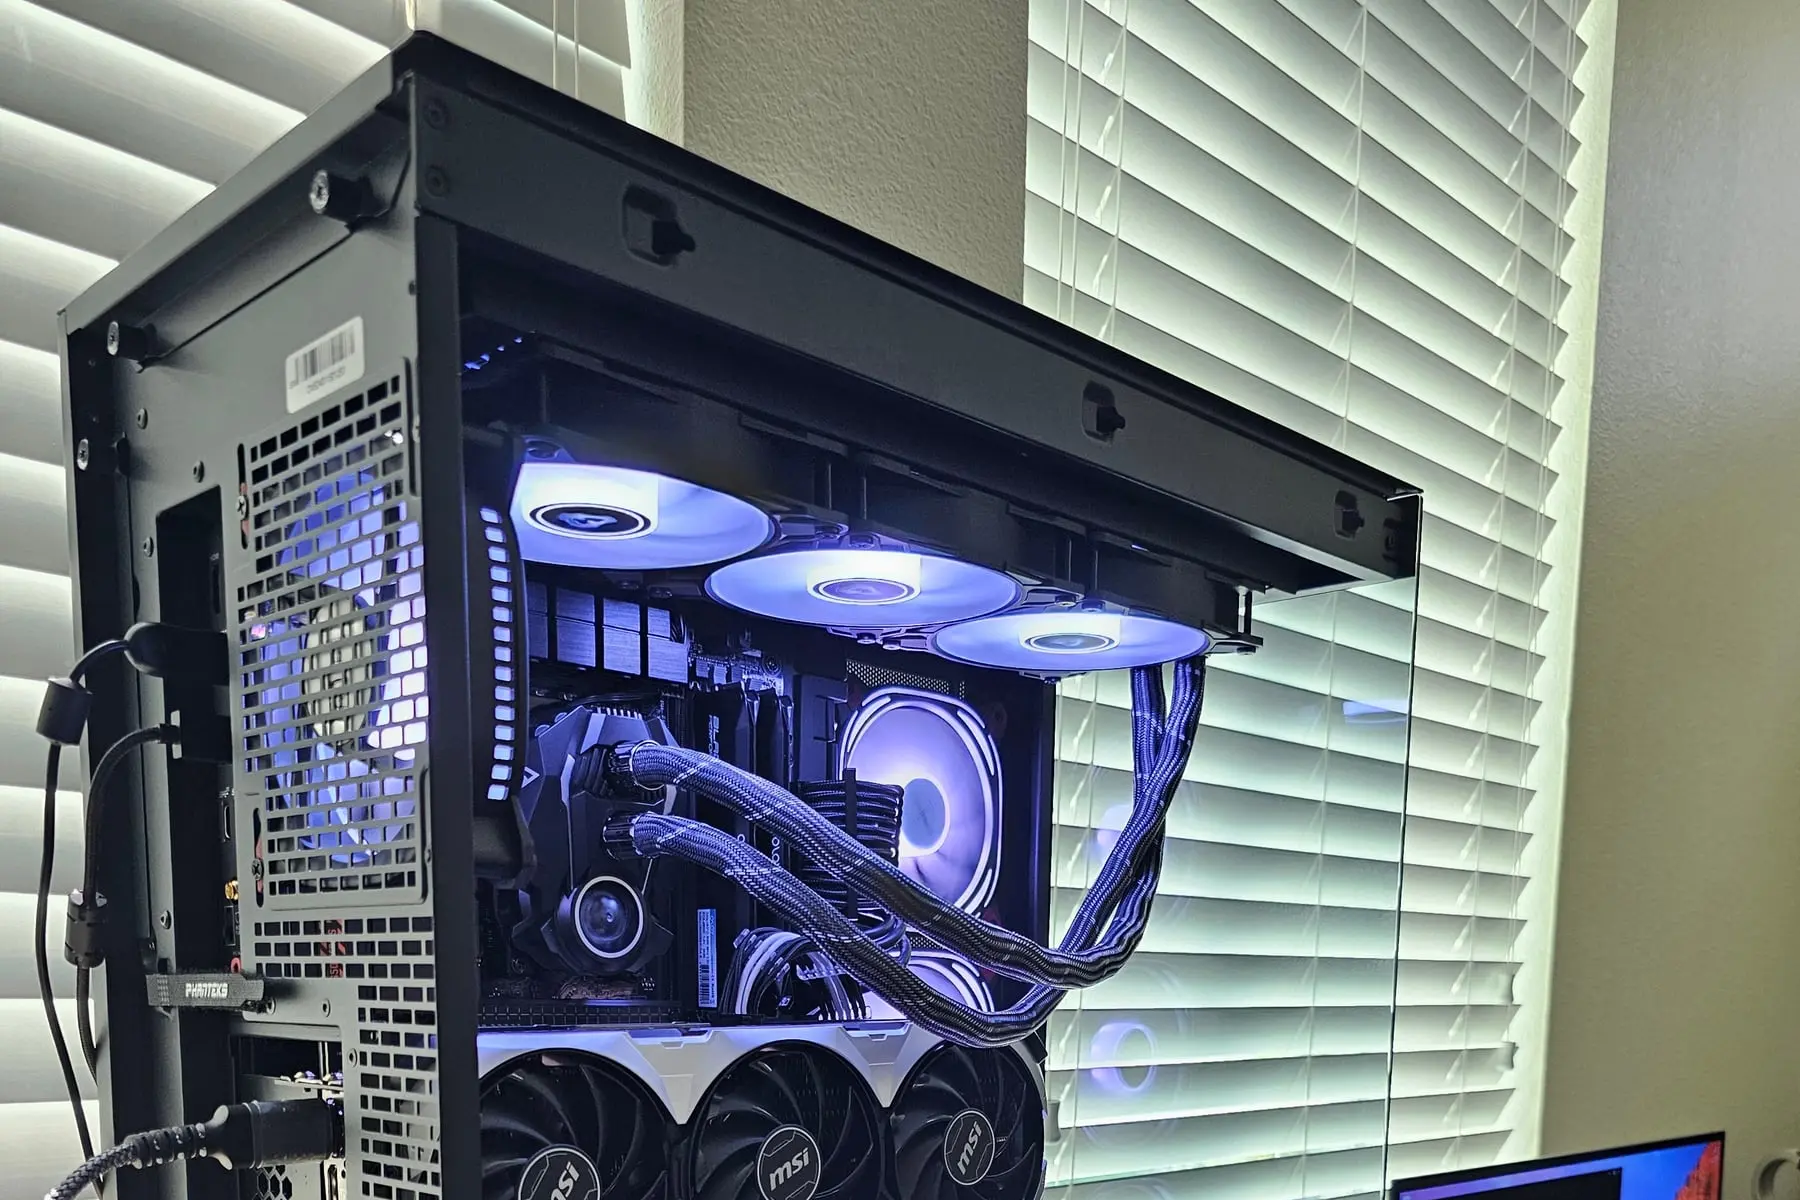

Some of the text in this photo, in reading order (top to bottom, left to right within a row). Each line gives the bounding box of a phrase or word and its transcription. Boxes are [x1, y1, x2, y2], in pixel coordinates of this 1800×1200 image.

[185, 982, 228, 998] PHANTEKS
[769, 1147, 809, 1192] msi
[957, 1122, 982, 1176] msi
